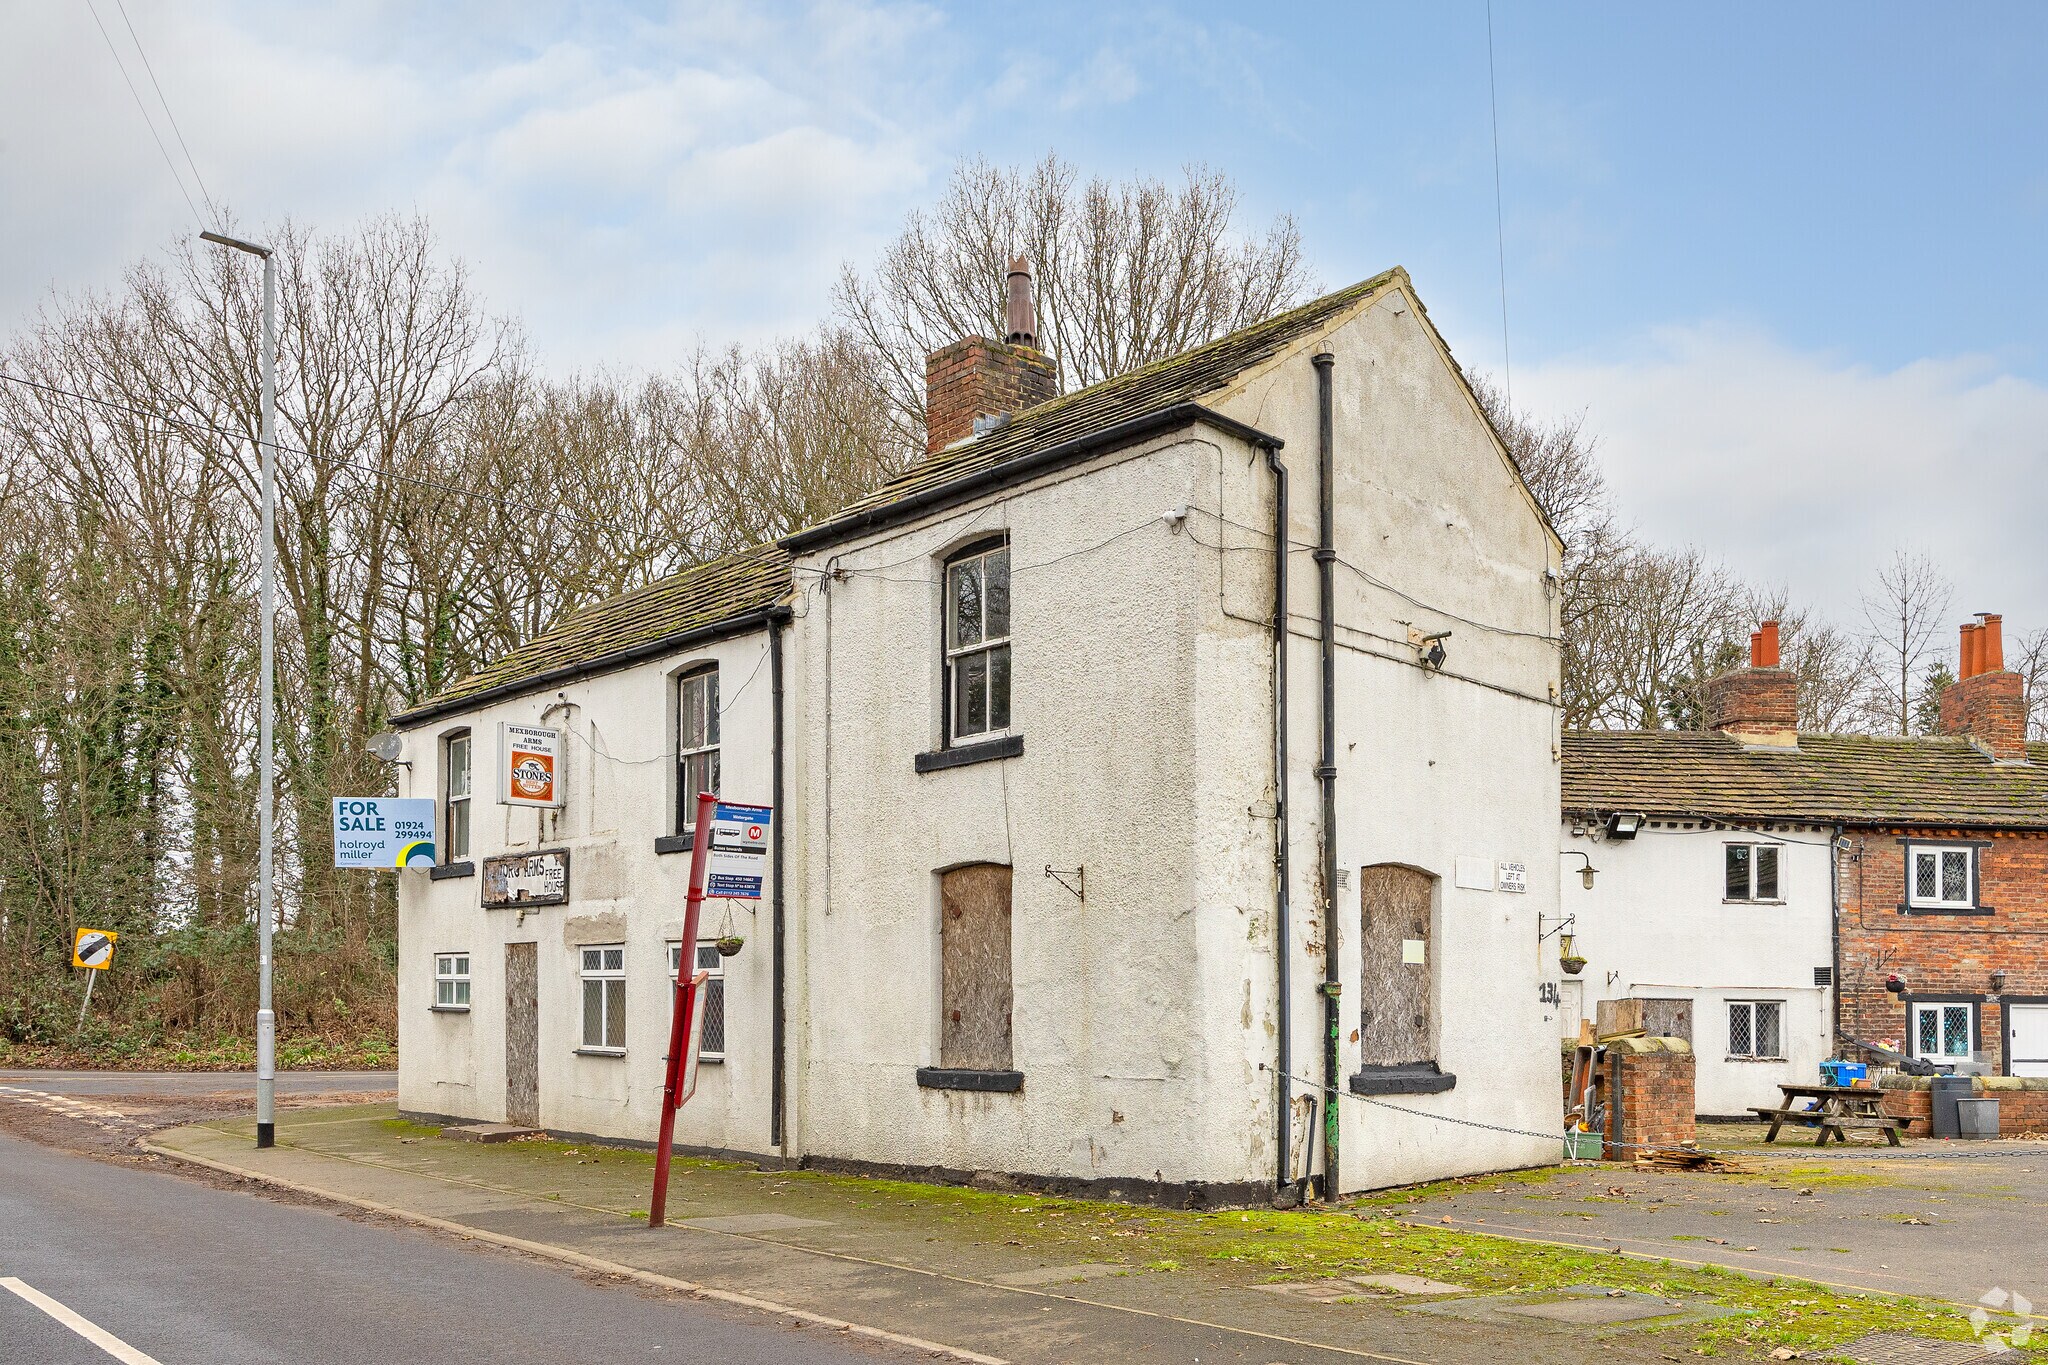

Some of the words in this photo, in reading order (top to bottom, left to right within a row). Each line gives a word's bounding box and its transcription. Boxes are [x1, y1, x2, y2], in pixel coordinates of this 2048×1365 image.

[509, 727, 556, 738] MEXBOROUGH
[513, 768, 552, 782] STONES
[339, 802, 379, 816] FOR
[340, 817, 386, 831] SALE
[395, 822, 424, 830] 01924
[750, 829, 760, 837] M
[340, 840, 385, 850] holroyd
[340, 850, 372, 859] miller
[1509, 863, 1525, 872] VEHICLES
[545, 868, 562, 880] FREE
[1539, 982, 1561, 1010] 134
